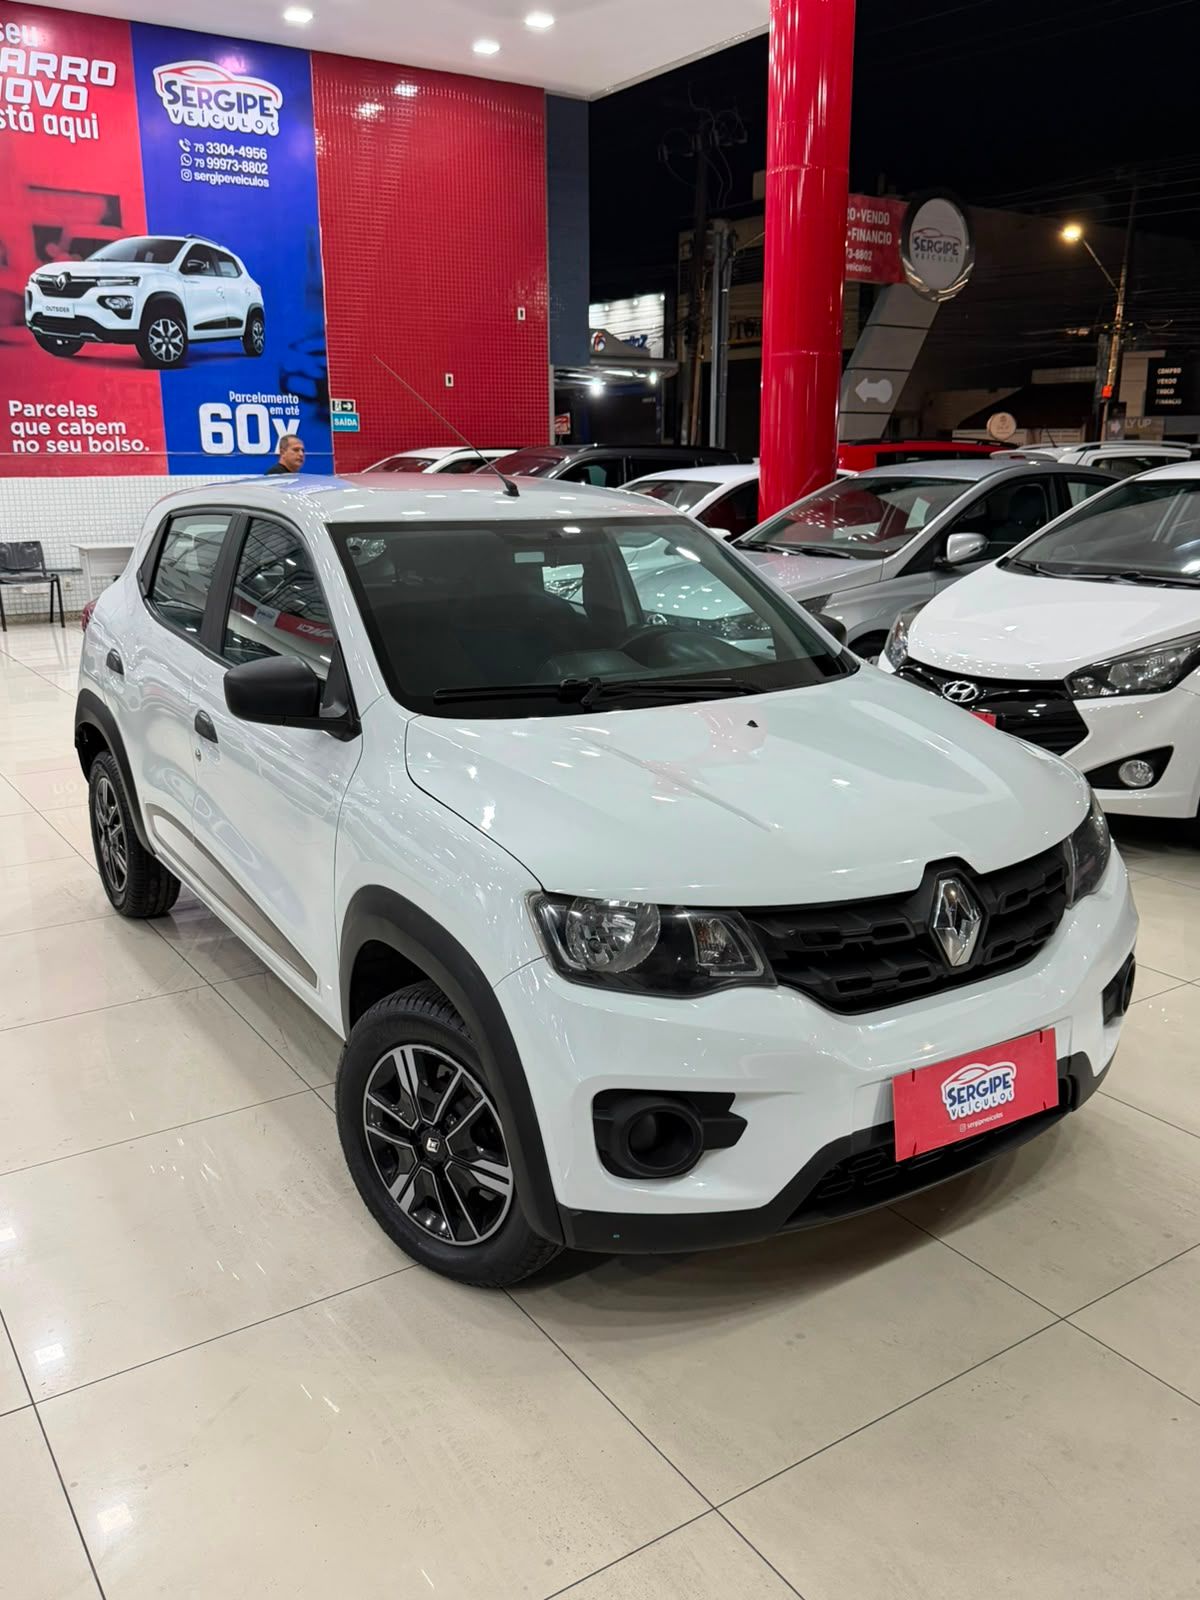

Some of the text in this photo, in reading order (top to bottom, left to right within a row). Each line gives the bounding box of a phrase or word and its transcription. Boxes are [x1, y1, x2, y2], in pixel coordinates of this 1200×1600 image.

[0, 75, 89, 111] OVO
[164, 80, 274, 118] SERGIPE
[43, 112, 100, 144] aqui
[193, 141, 268, 161] 79 3304-4956
[194, 156, 269, 175] 79 99973-8802
[193, 170, 270, 188] sergipeveiculos
[914, 236, 959, 255] SERGIPE
[228, 390, 300, 405] Parcelamento
[8, 399, 99, 418] Parcelas
[269, 405, 300, 416] em até
[10, 418, 127, 438] que cabem
[334, 415, 358, 427] SAÍDA
[12, 435, 150, 454] no seu bolso.
[947, 1072, 1011, 1107] SERGIPE
